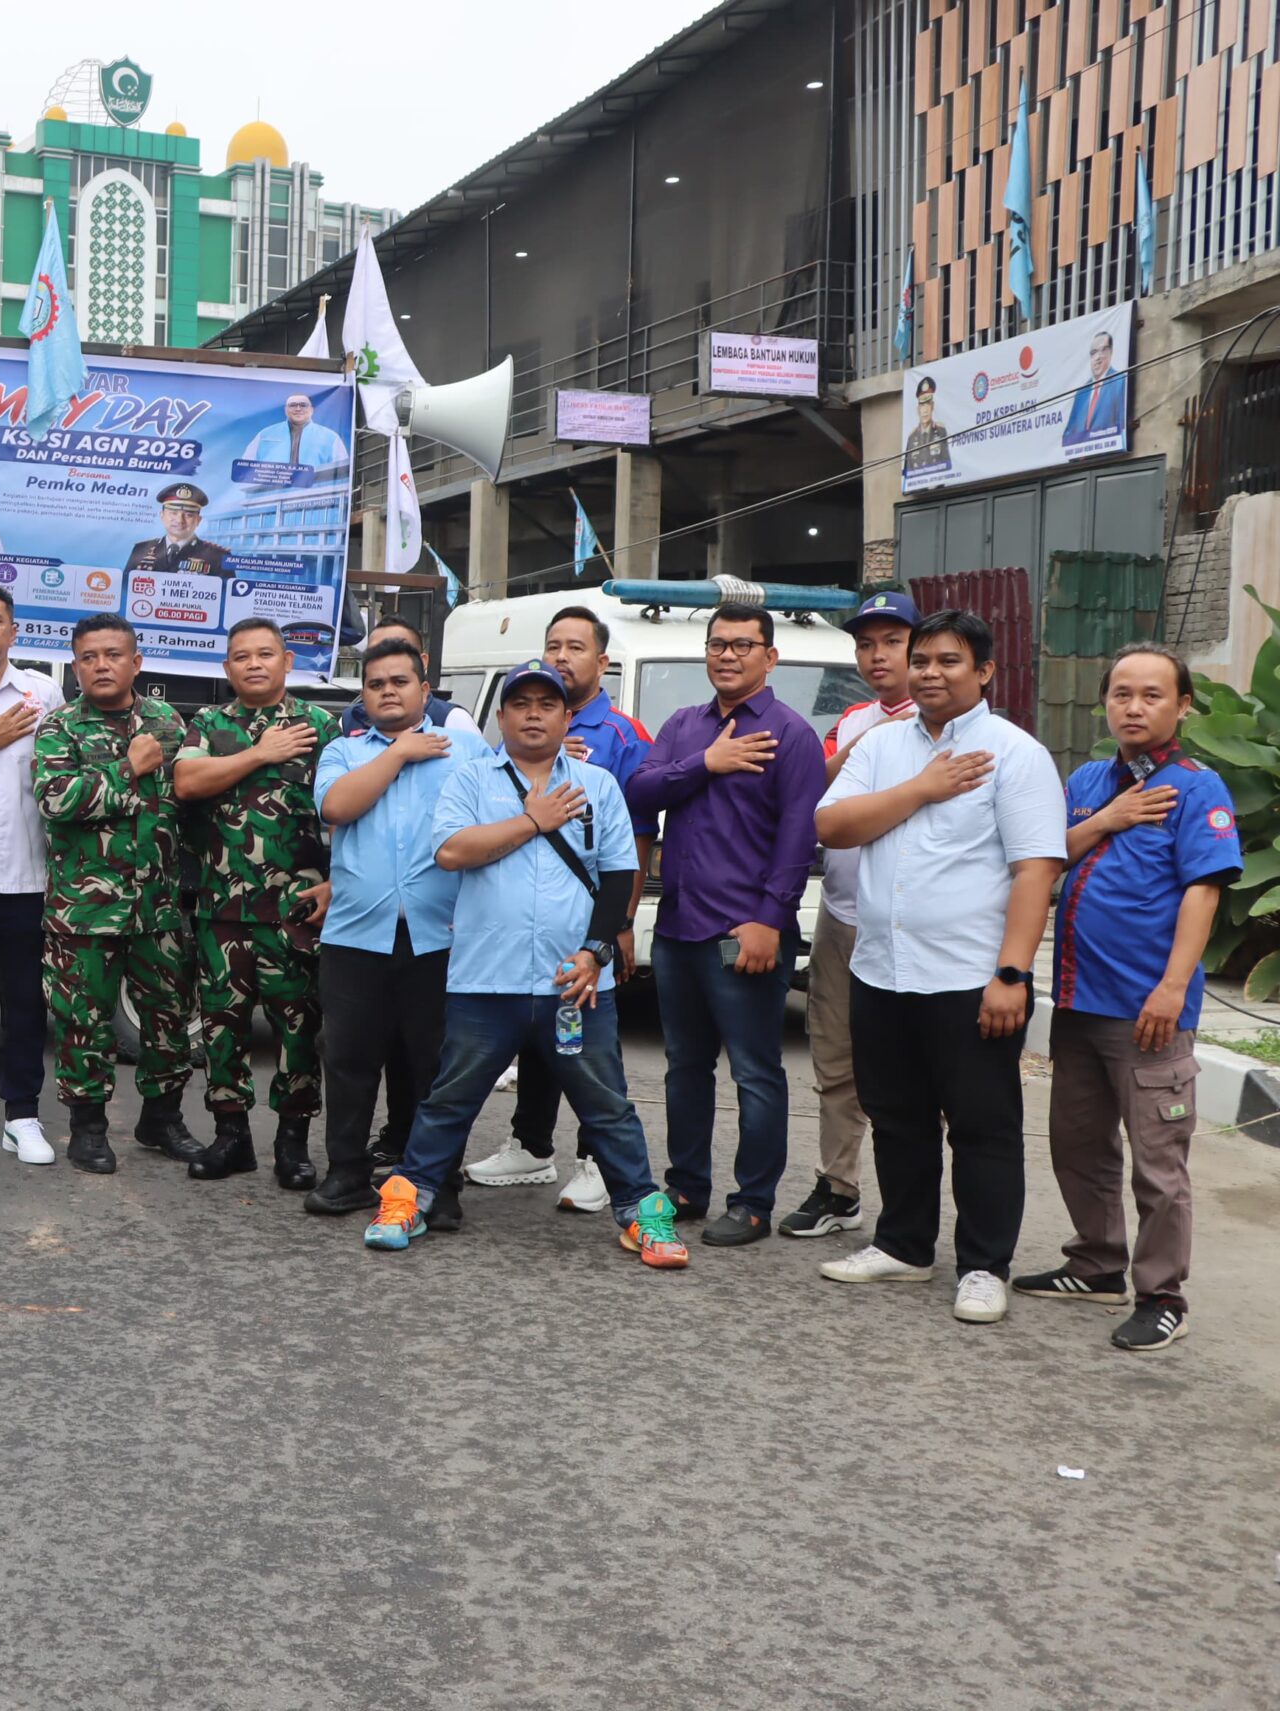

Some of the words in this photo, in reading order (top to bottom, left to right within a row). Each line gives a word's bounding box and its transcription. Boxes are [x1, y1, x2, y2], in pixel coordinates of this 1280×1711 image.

[712, 345, 749, 360] LEMBAGA
[750, 348, 787, 362] BANTUAN
[789, 350, 816, 364] HUKUM
[93, 394, 212, 438] DAY
[976, 408, 991, 425] DPD
[951, 428, 987, 448] PROVINSI
[989, 417, 1033, 439] SUMATERA
[1034, 409, 1063, 429] UTARA
[73, 435, 130, 456] AGN
[134, 439, 196, 461] 2026
[16, 449, 48, 462] DAN
[52, 452, 124, 468] Persatuan
[128, 457, 172, 472] Buruh
[67, 468, 113, 480] Bersama
[25, 476, 86, 494] Pemko
[90, 482, 149, 498] Medan
[16, 556, 50, 566] KEGIATAN
[225, 556, 240, 564] JEAN
[264, 559, 304, 569] SIMANJUNTAK
[32, 588, 71, 596] PEMERIKSAAN
[255, 582, 276, 590] LOKASI
[277, 584, 306, 592] KEGIATAN
[34, 594, 67, 602] KESEHATAN
[161, 589, 166, 597] 1
[170, 589, 190, 599] MEI
[192, 591, 217, 601] 2026
[254, 591, 277, 600] PINTU
[278, 592, 298, 601] HALL
[299, 594, 324, 603] TIMUR
[160, 601, 180, 609] MULAI
[181, 603, 203, 611] PUKUL
[254, 599, 287, 608] STADION
[288, 601, 323, 611] TELADAN
[158, 609, 182, 620] 06.00
[183, 612, 204, 621] PAGI
[34, 638, 60, 648] GARIS
[158, 633, 215, 650] Rahmad
[145, 648, 170, 657] SAMA
